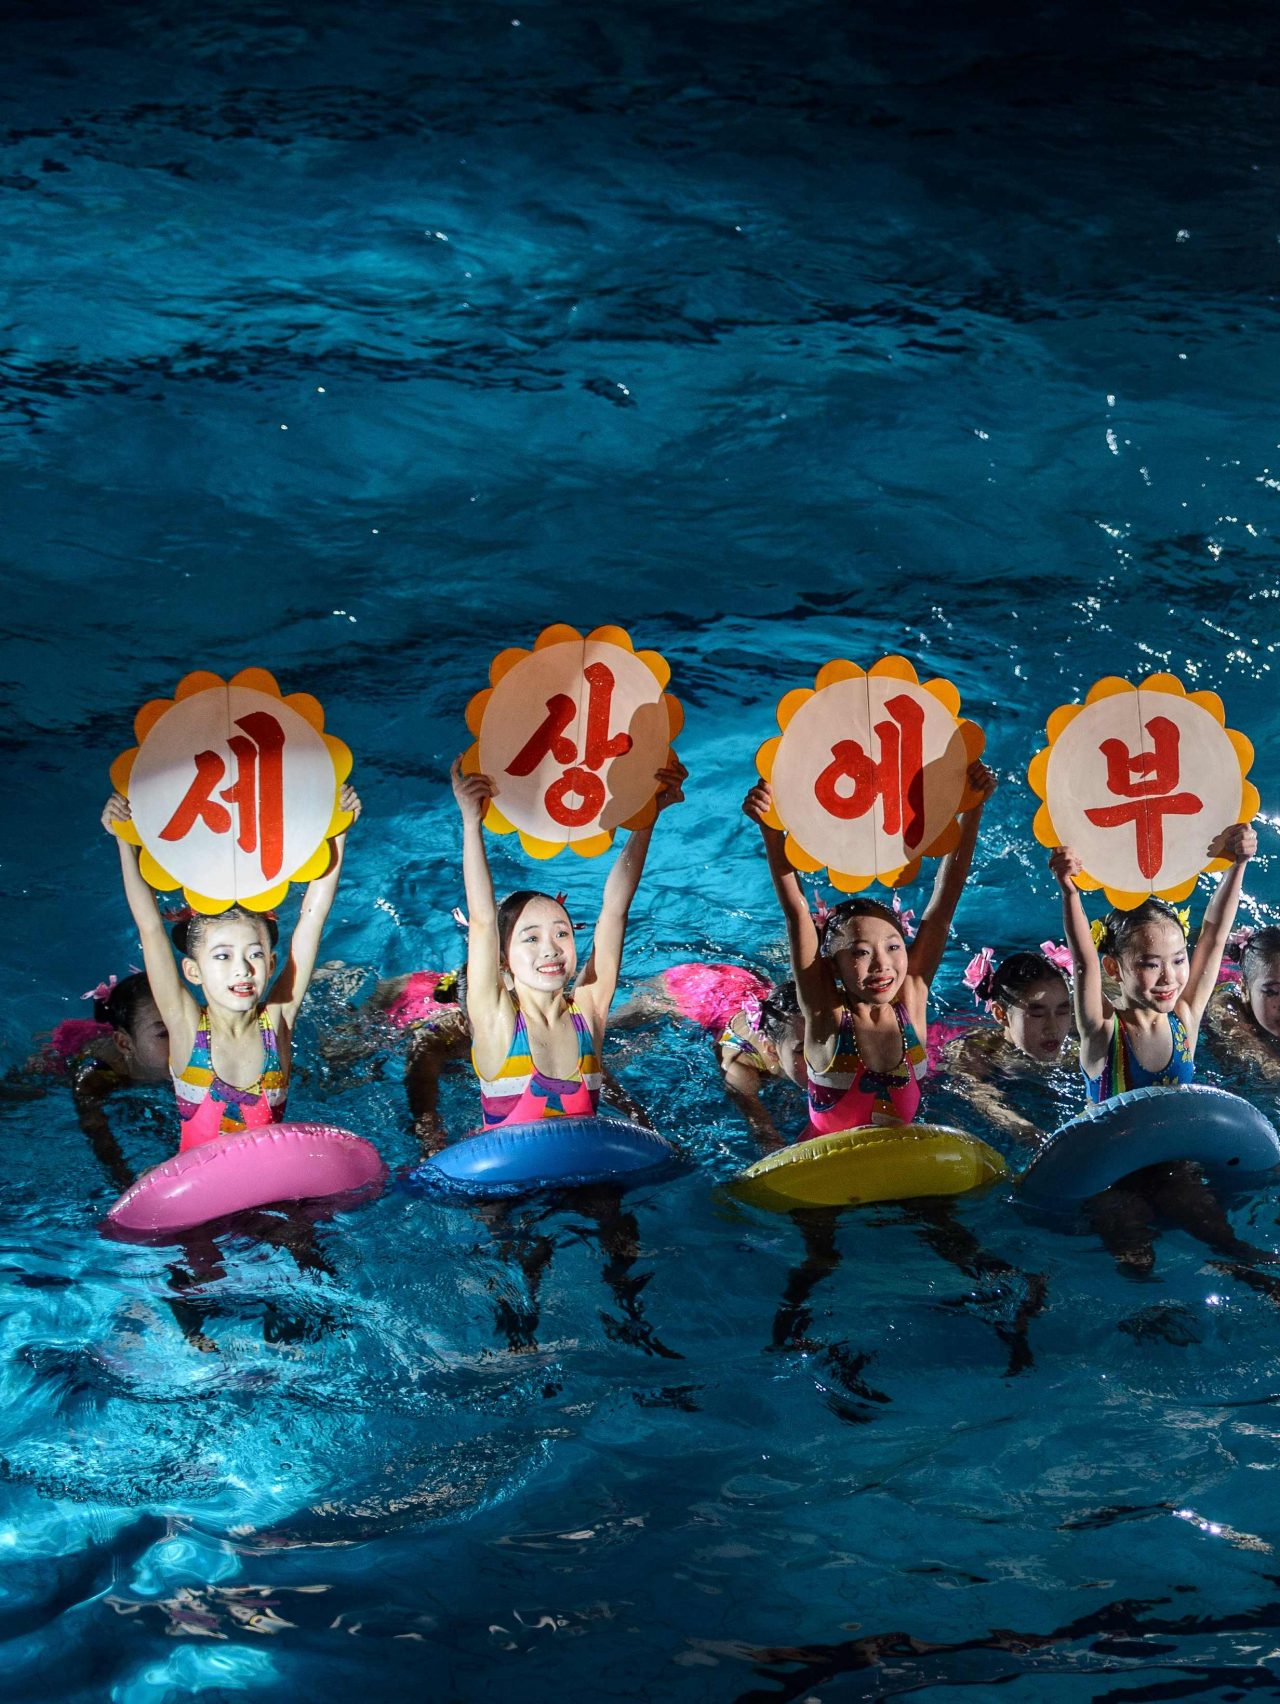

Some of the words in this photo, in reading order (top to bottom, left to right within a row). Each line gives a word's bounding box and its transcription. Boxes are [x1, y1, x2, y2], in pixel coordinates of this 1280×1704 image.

[159, 711, 285, 881] 세
[504, 661, 633, 828] 상
[814, 694, 926, 850] 에
[1085, 715, 1204, 880] 부
